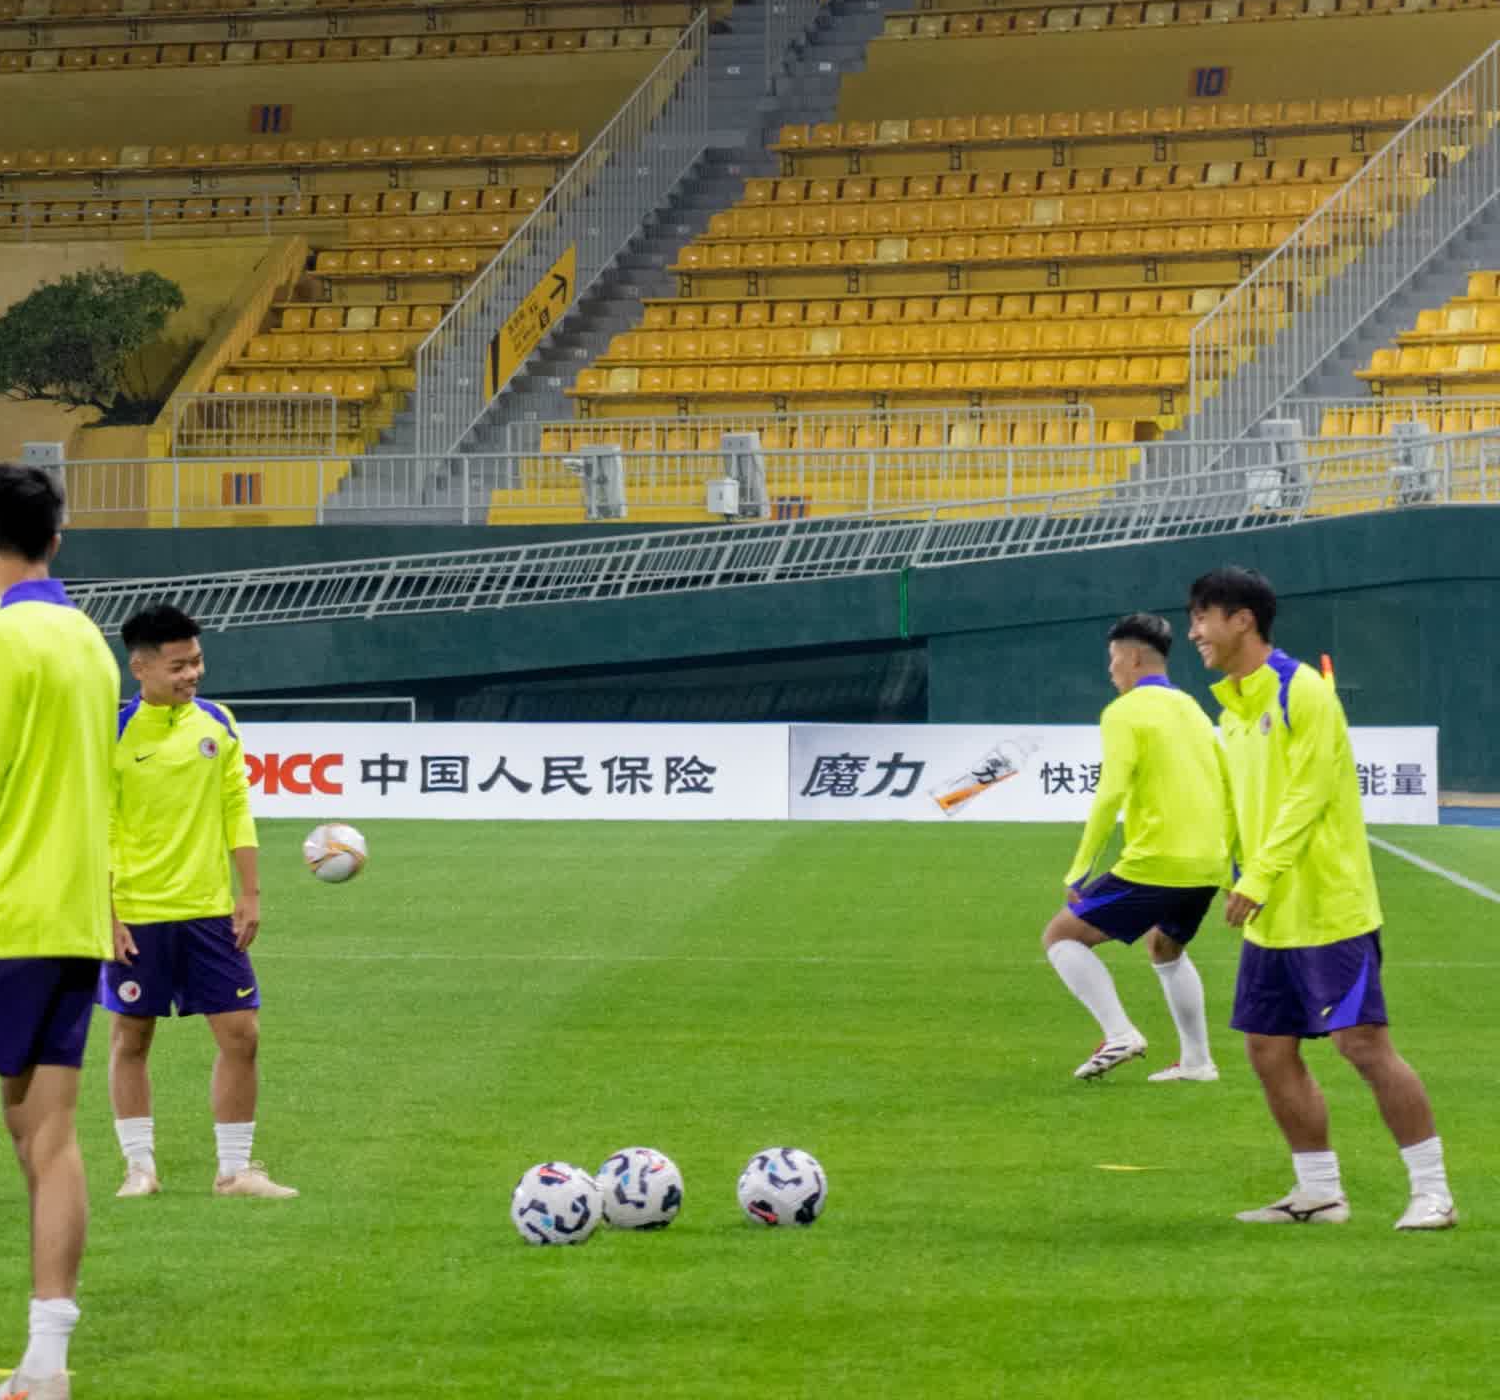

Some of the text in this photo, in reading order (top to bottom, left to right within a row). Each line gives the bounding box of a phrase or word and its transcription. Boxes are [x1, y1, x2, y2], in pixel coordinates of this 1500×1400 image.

[360, 752, 718, 797] 中国人民保险
[800, 751, 927, 799] 魔力
